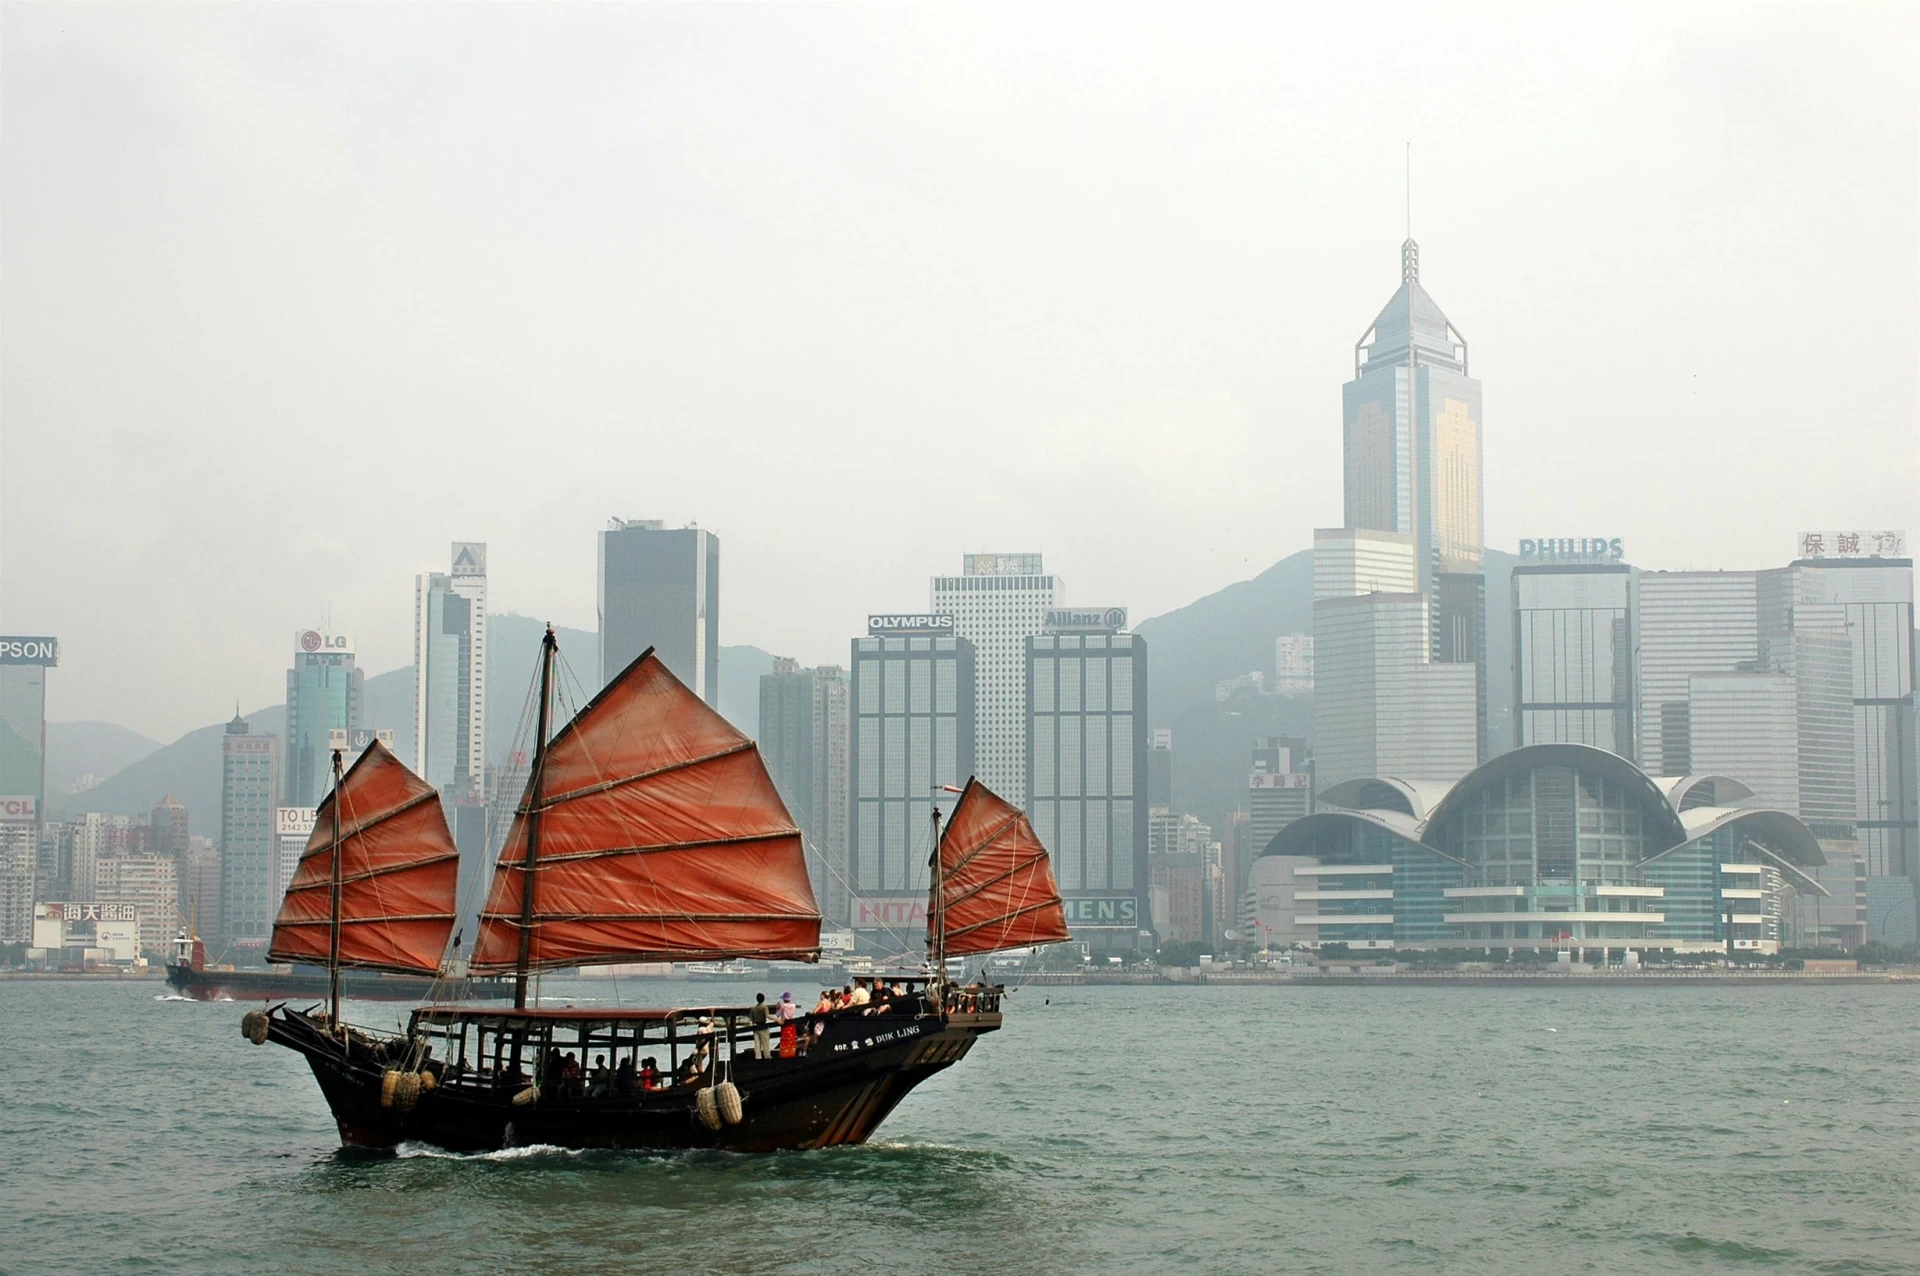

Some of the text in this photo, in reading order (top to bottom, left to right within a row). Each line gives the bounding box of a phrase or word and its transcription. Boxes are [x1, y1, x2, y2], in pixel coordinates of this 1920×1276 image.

[1520, 538, 1624, 560] PHILIPS
[1802, 533, 1860, 554] 保誠
[869, 616, 953, 628] OLYMPUS
[1046, 611, 1101, 626] Allianz
[325, 635, 347, 648] LG
[279, 809, 298, 822] TO
[860, 902, 928, 922] HITA
[876, 1032, 894, 1044] DUK
[896, 1025, 920, 1038] LING
